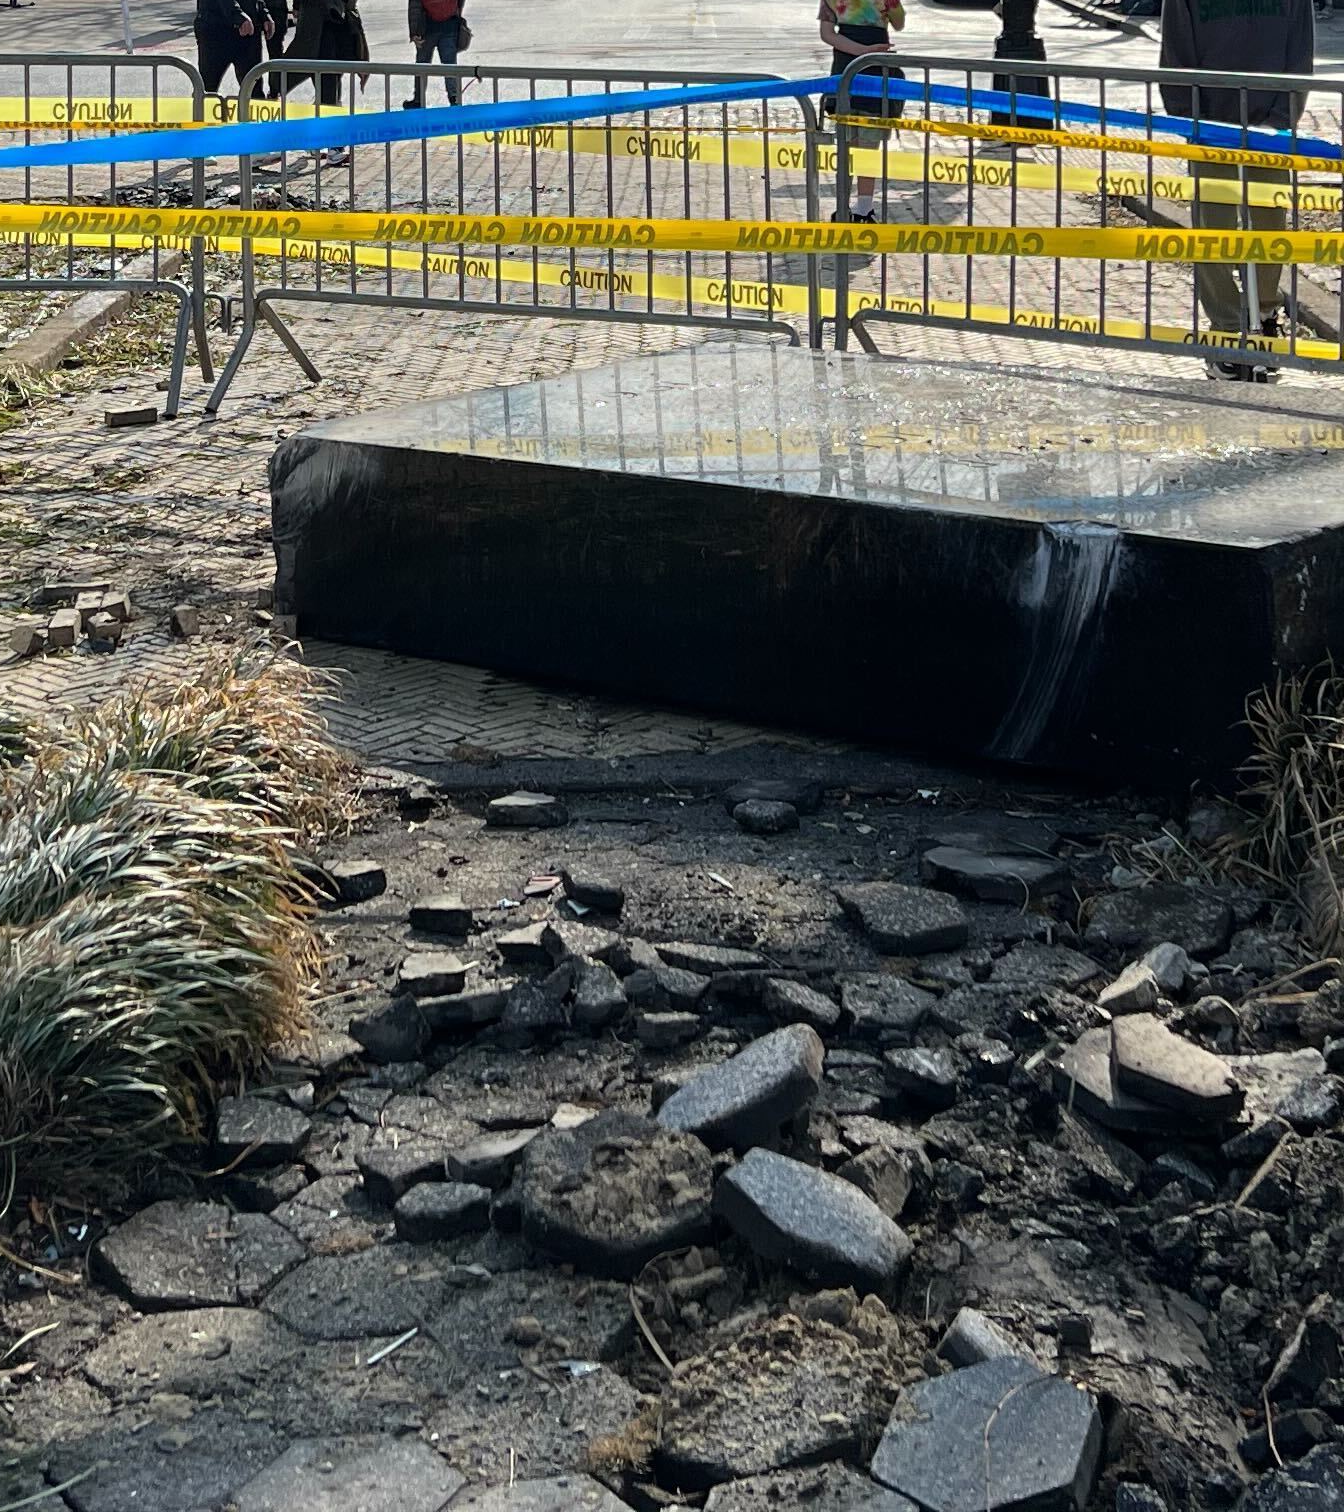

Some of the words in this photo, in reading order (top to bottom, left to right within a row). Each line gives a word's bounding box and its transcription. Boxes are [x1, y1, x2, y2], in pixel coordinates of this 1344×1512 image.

[141, 236, 219, 253] CAUTN
[420, 256, 490, 278] CAUTION
[559, 268, 633, 294] CAUTION
[707, 281, 784, 309] CAUTION
[859, 295, 935, 316] CATIO
[1182, 332, 1274, 354] CAUTON
